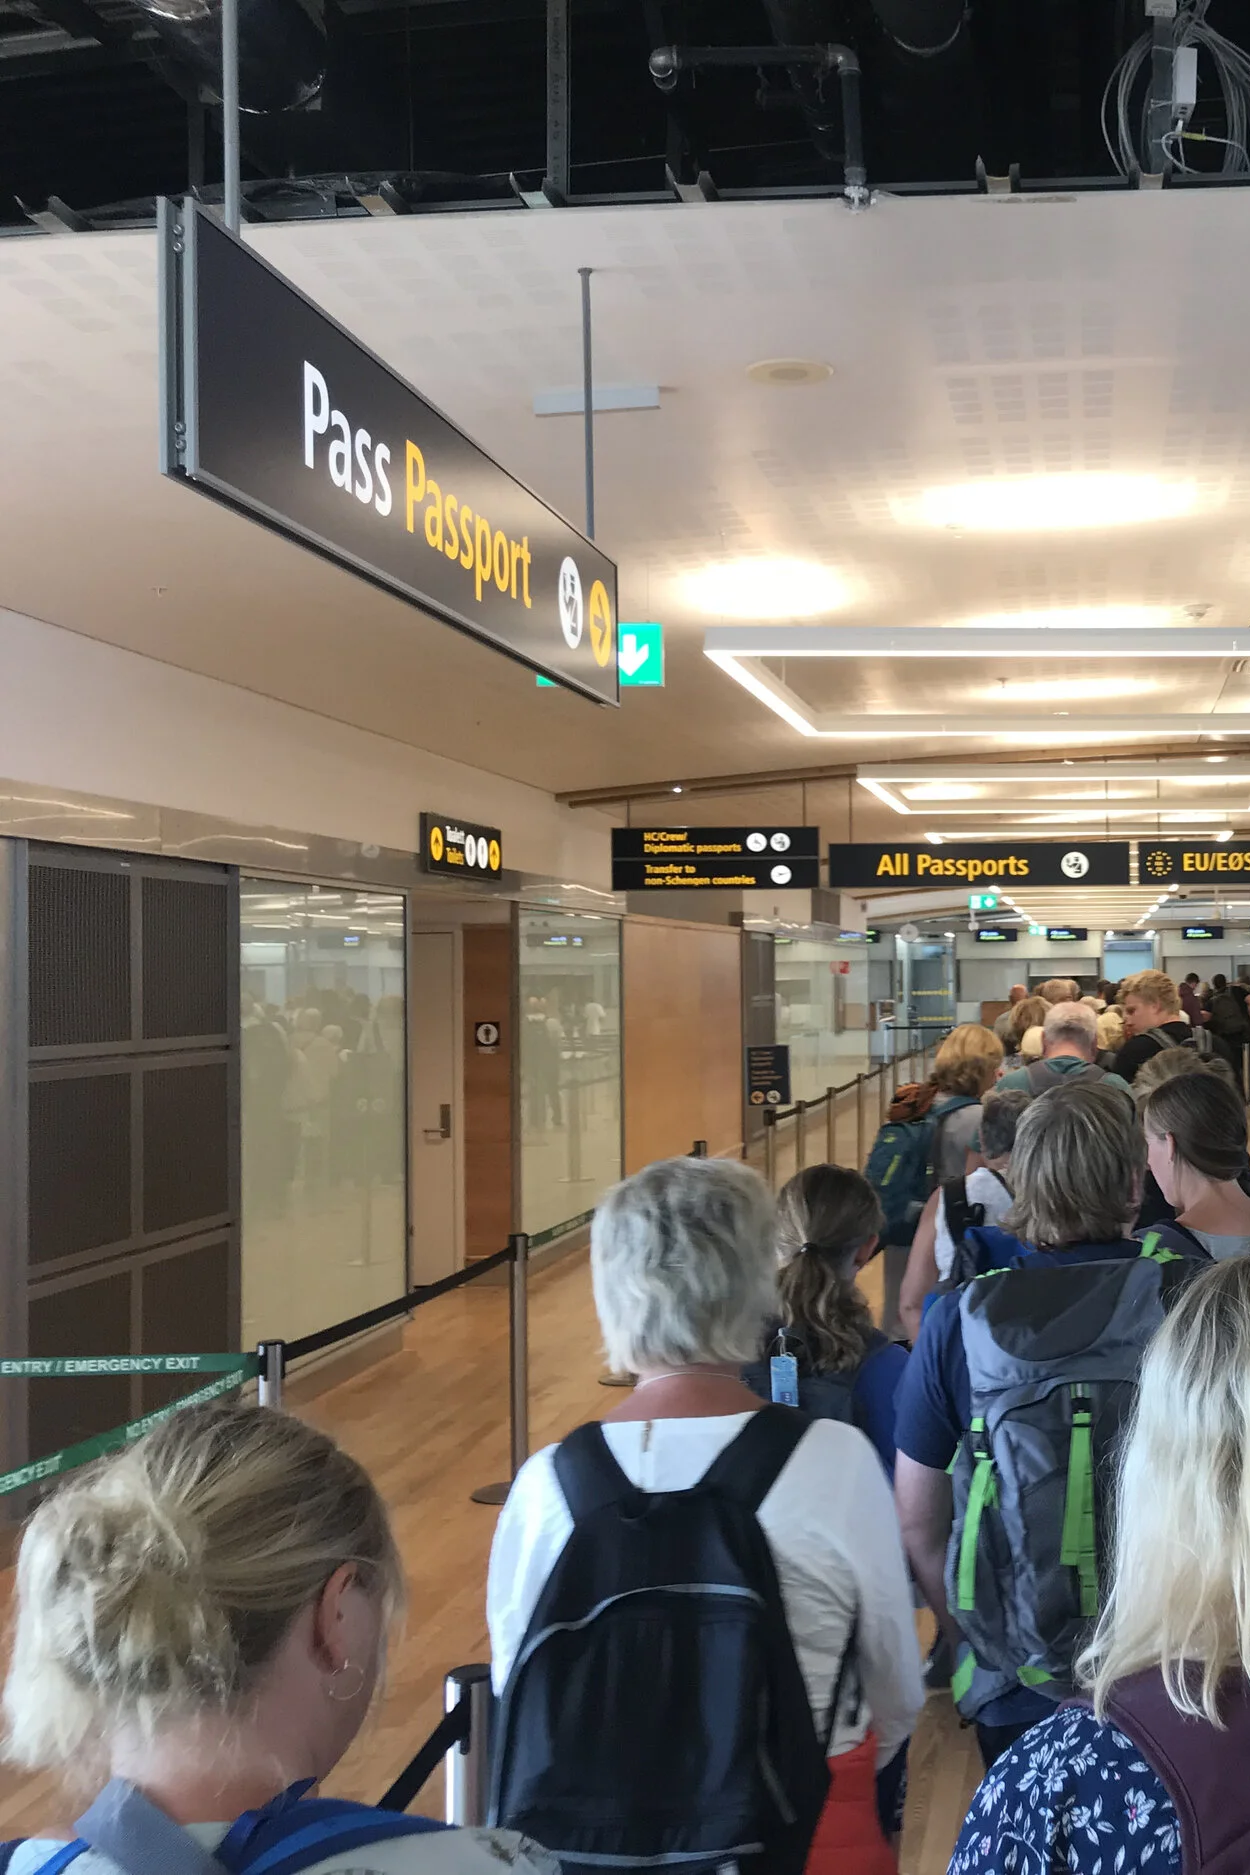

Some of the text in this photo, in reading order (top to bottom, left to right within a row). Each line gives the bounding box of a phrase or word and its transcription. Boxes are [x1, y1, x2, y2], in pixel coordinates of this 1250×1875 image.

[304, 360, 532, 608] Pass Passport
[644, 843, 742, 854] Diplomatic passports
[644, 864, 696, 874] Transfer to
[876, 852, 1029, 881] All Passports
[644, 874, 756, 886] non-Schengen countries
[1, 1360, 53, 1374] ENTRY
[64, 1357, 162, 1373] EMERGENCY
[164, 1356, 200, 1371] EXIT
